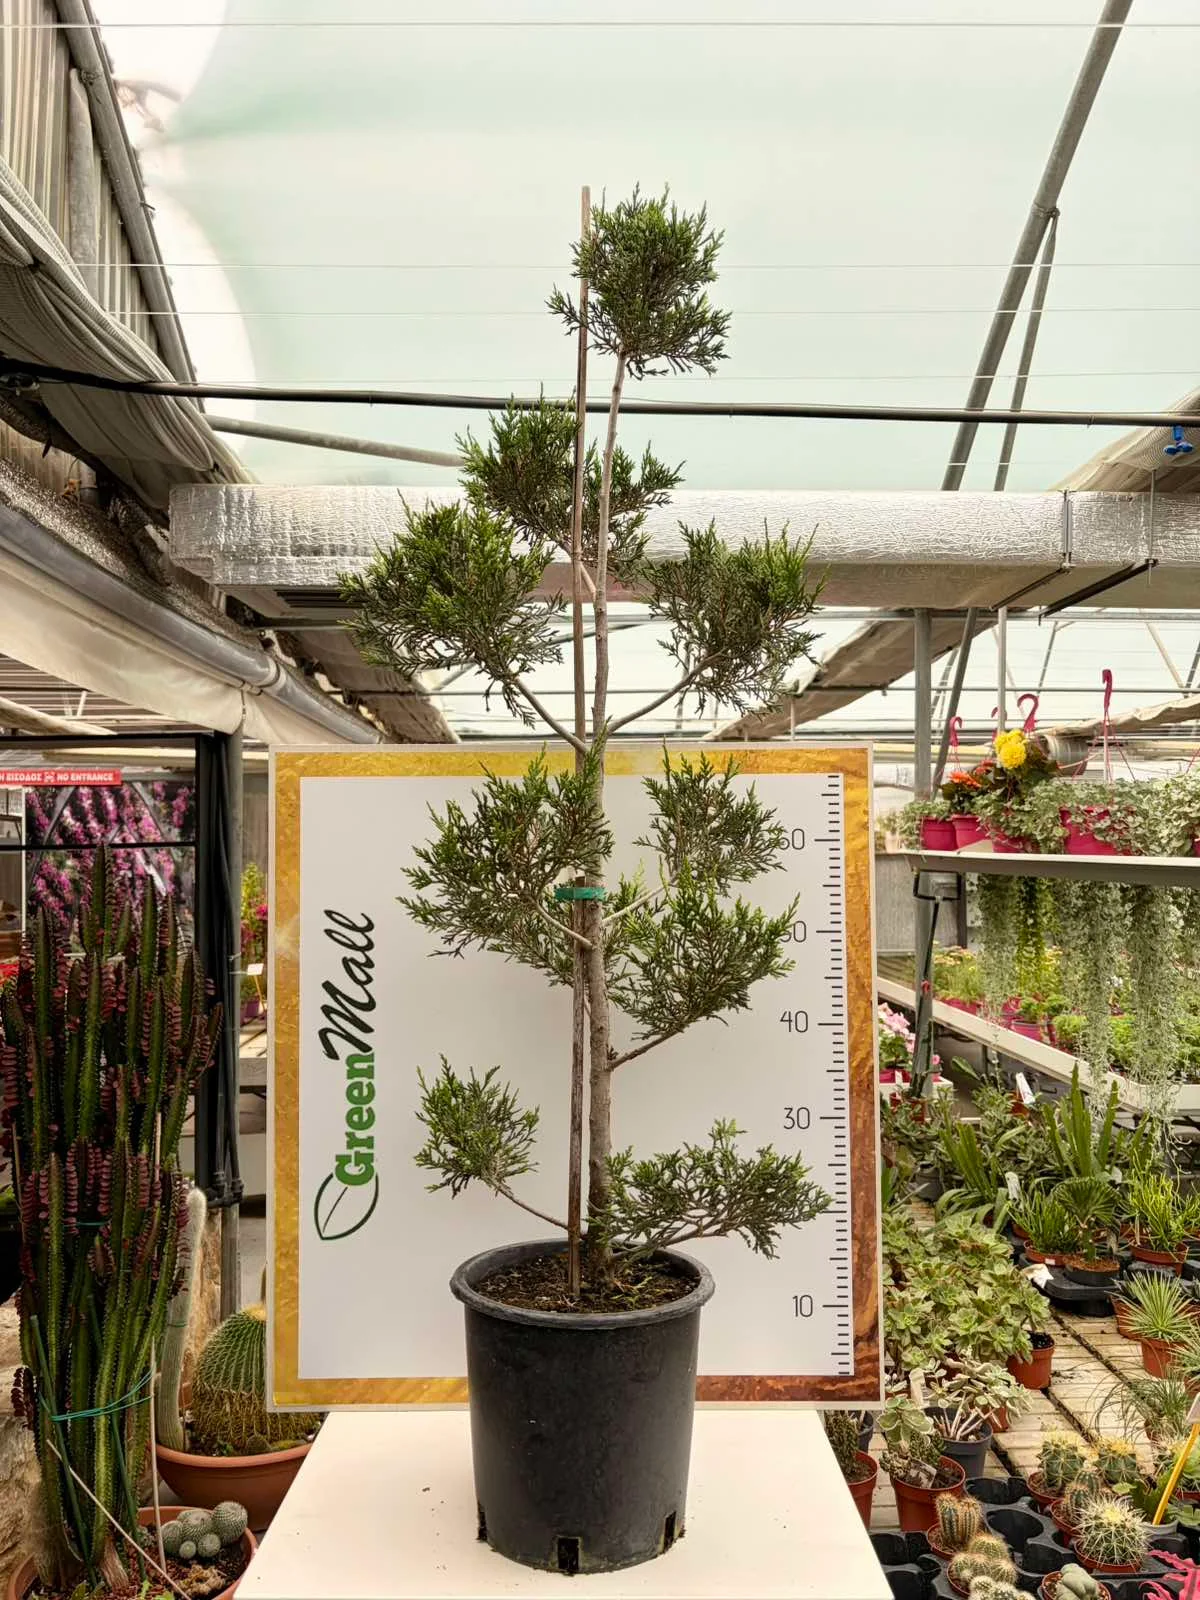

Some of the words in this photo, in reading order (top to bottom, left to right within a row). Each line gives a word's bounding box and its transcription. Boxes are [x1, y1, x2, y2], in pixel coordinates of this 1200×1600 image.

[57, 772, 69, 781] NO
[70, 772, 114, 781] ENTRANCE
[779, 1010, 808, 1033] 40
[783, 1106, 810, 1130] 30
[792, 1294, 813, 1317] 10
